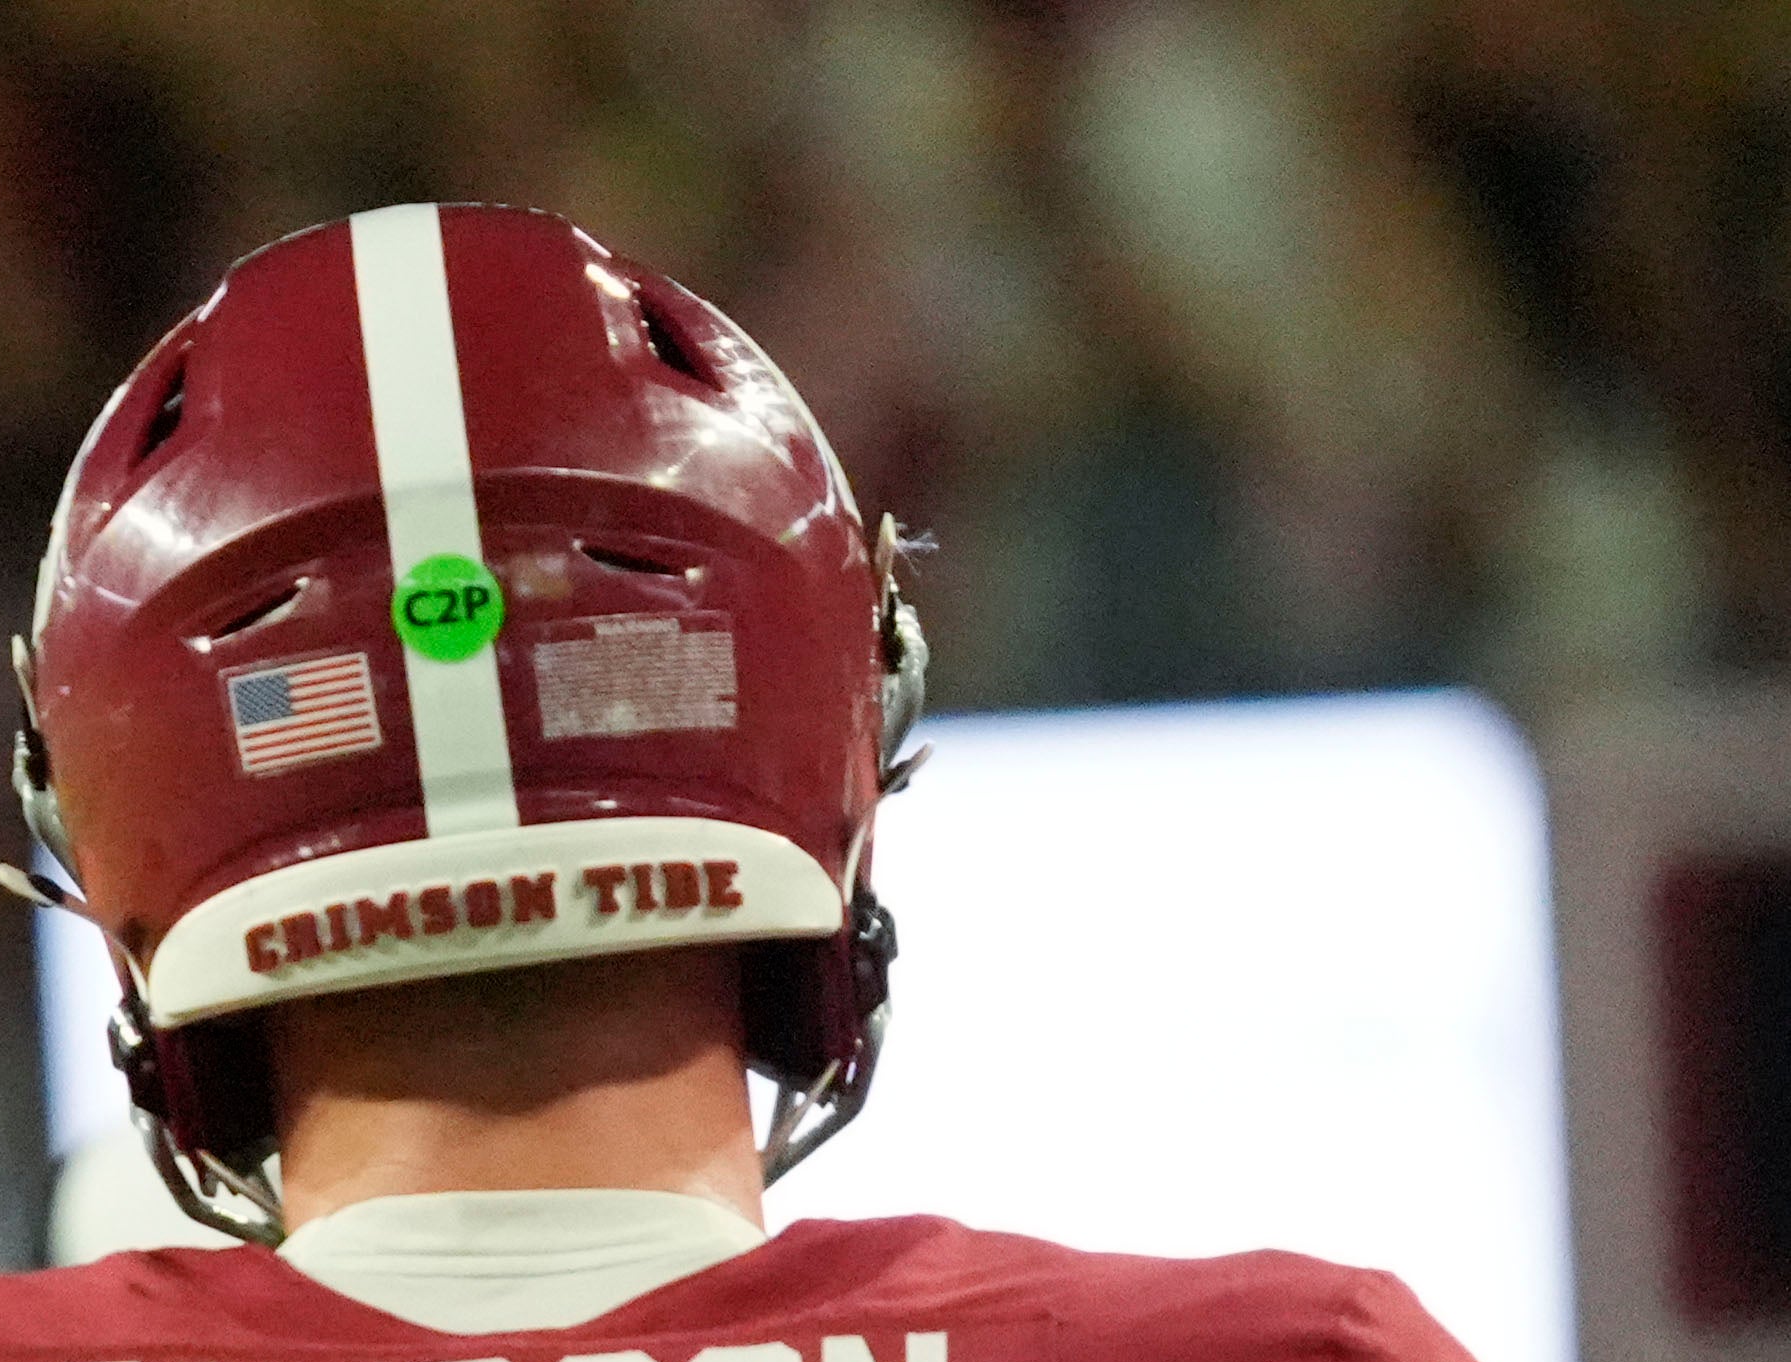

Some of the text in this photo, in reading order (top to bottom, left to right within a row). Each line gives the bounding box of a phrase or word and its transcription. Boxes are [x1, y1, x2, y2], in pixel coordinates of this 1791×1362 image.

[405, 585, 490, 627] C2P
[245, 860, 745, 973] CRIMSON TIDE
